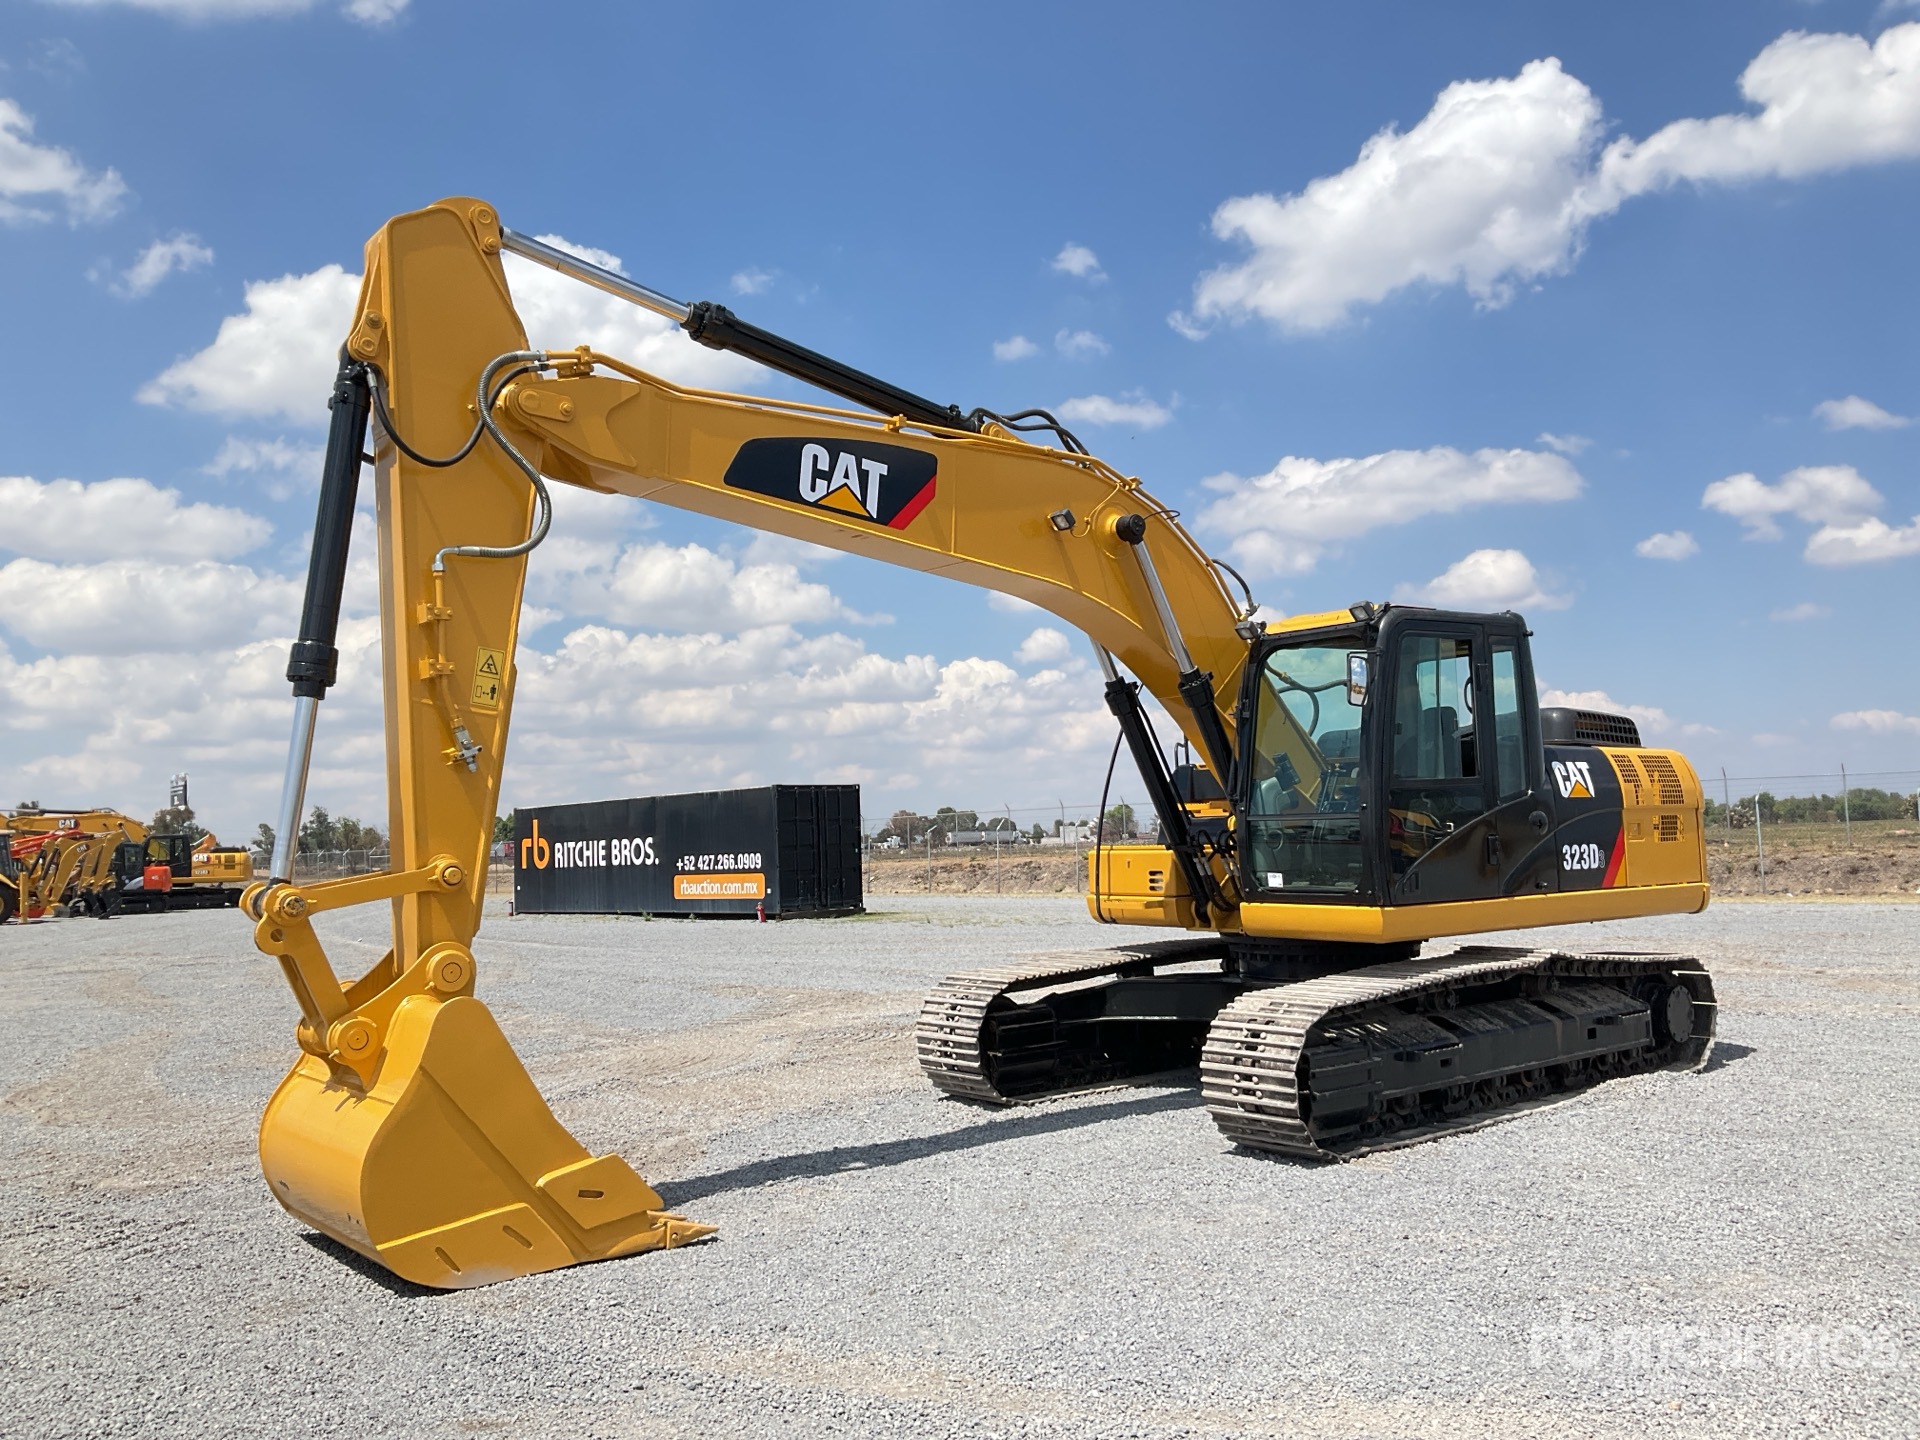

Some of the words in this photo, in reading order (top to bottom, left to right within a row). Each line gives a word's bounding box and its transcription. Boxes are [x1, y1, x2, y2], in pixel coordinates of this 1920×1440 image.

[799, 443, 888, 519] CAT
[1551, 761, 1595, 798] CAT
[58, 819, 76, 829] CAT
[521, 818, 550, 869] rb
[554, 840, 607, 868] RITCHIE
[611, 836, 660, 866] BROS.
[193, 853, 208, 863] CAT
[676, 855, 696, 871] +52
[697, 852, 762, 871] 427.266.0909
[680, 879, 758, 895] rbauction.com.mx
